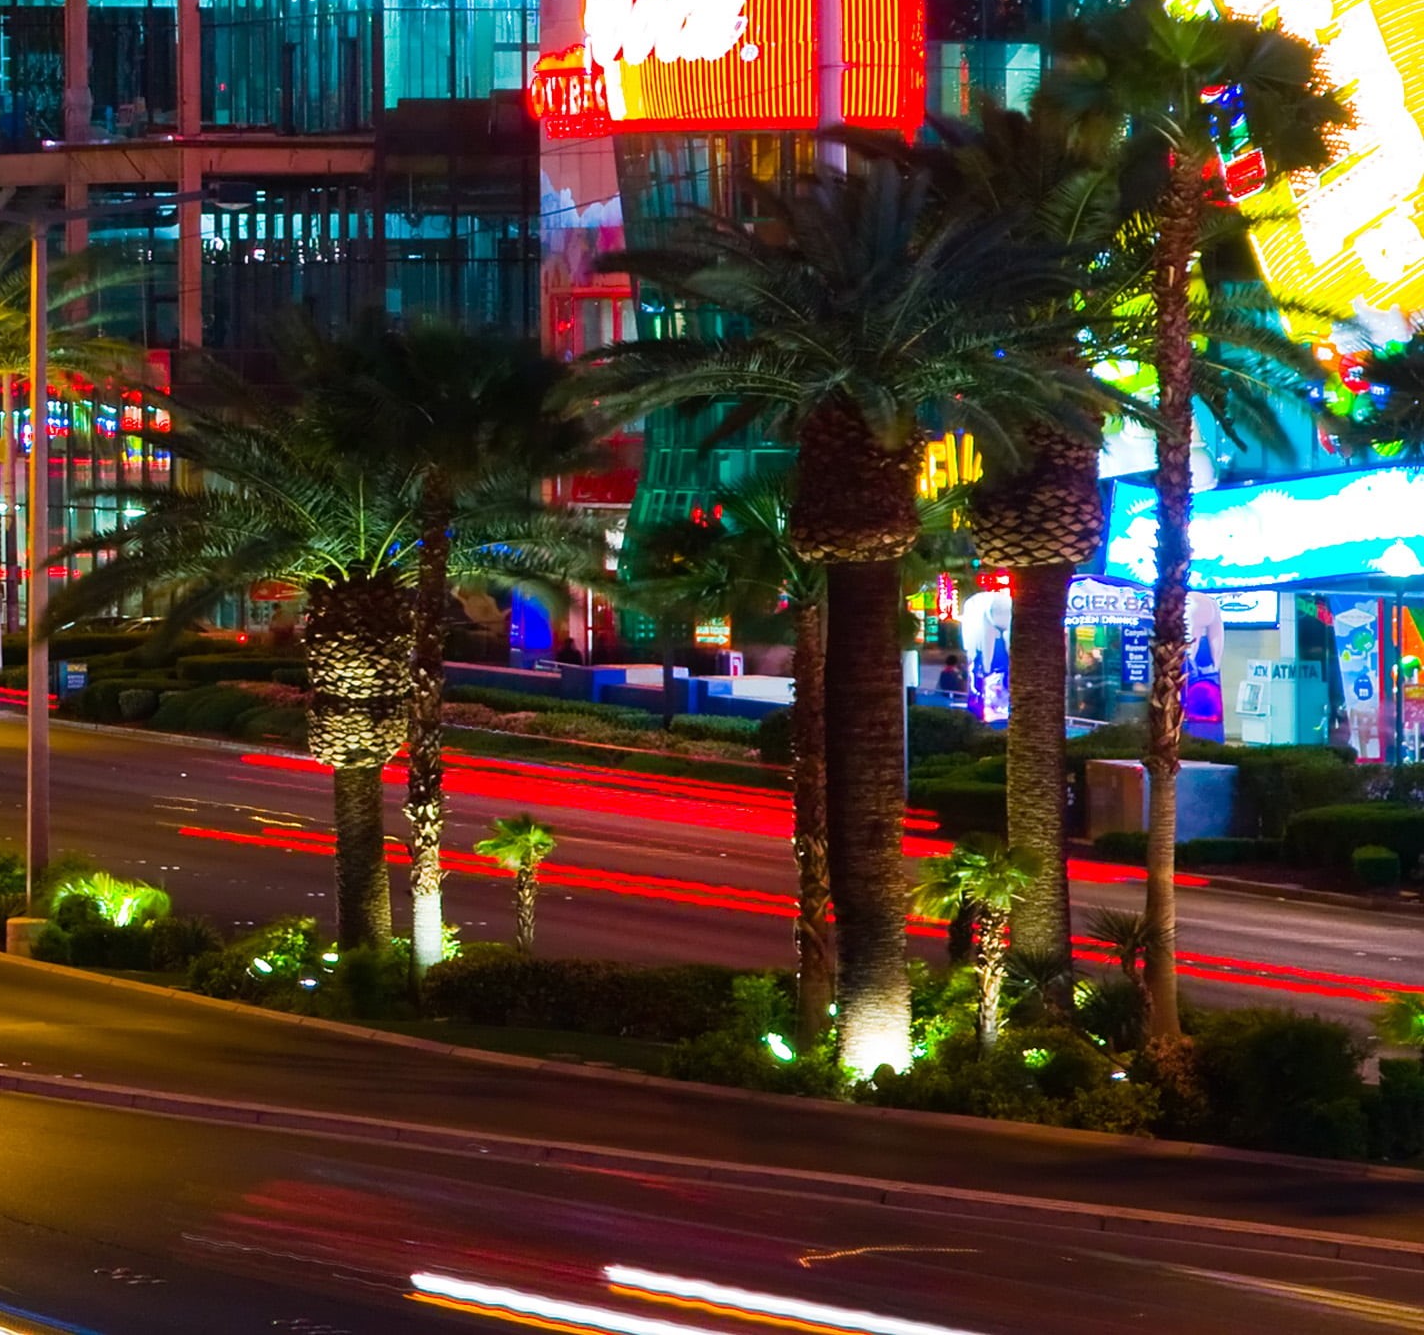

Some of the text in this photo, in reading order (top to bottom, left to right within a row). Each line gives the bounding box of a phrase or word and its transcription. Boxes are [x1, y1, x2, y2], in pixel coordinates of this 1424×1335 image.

[532, 74, 607, 118] OUTBAC
[1065, 594, 1154, 613] CIER BA
[1064, 616, 1140, 626] ROZEN DRINKS
